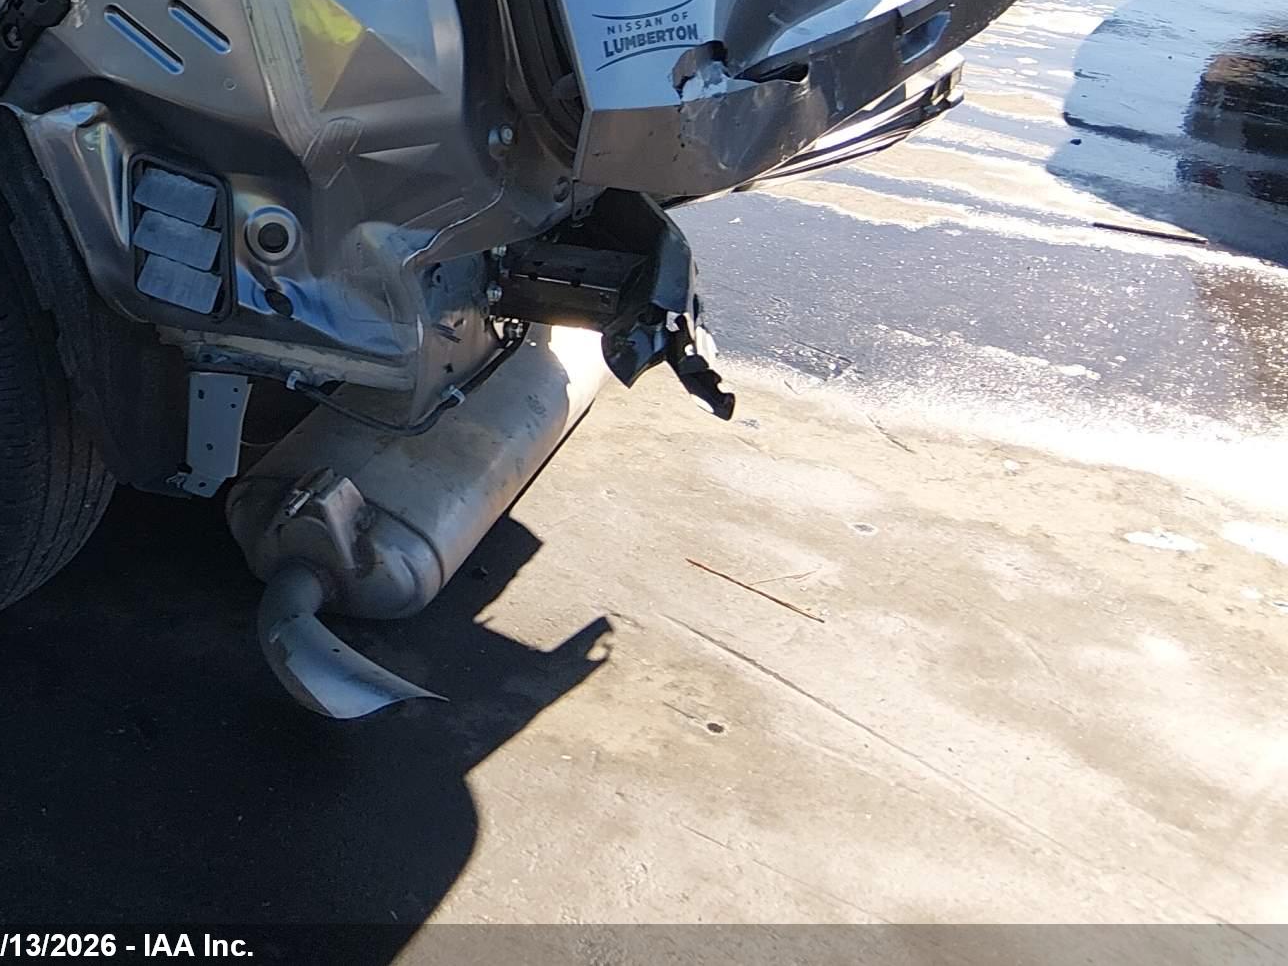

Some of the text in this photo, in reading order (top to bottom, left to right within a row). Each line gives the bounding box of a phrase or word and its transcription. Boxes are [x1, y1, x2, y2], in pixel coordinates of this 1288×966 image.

[606, 11, 689, 35] NISSAN OF
[602, 23, 699, 58] LUMBERTON
